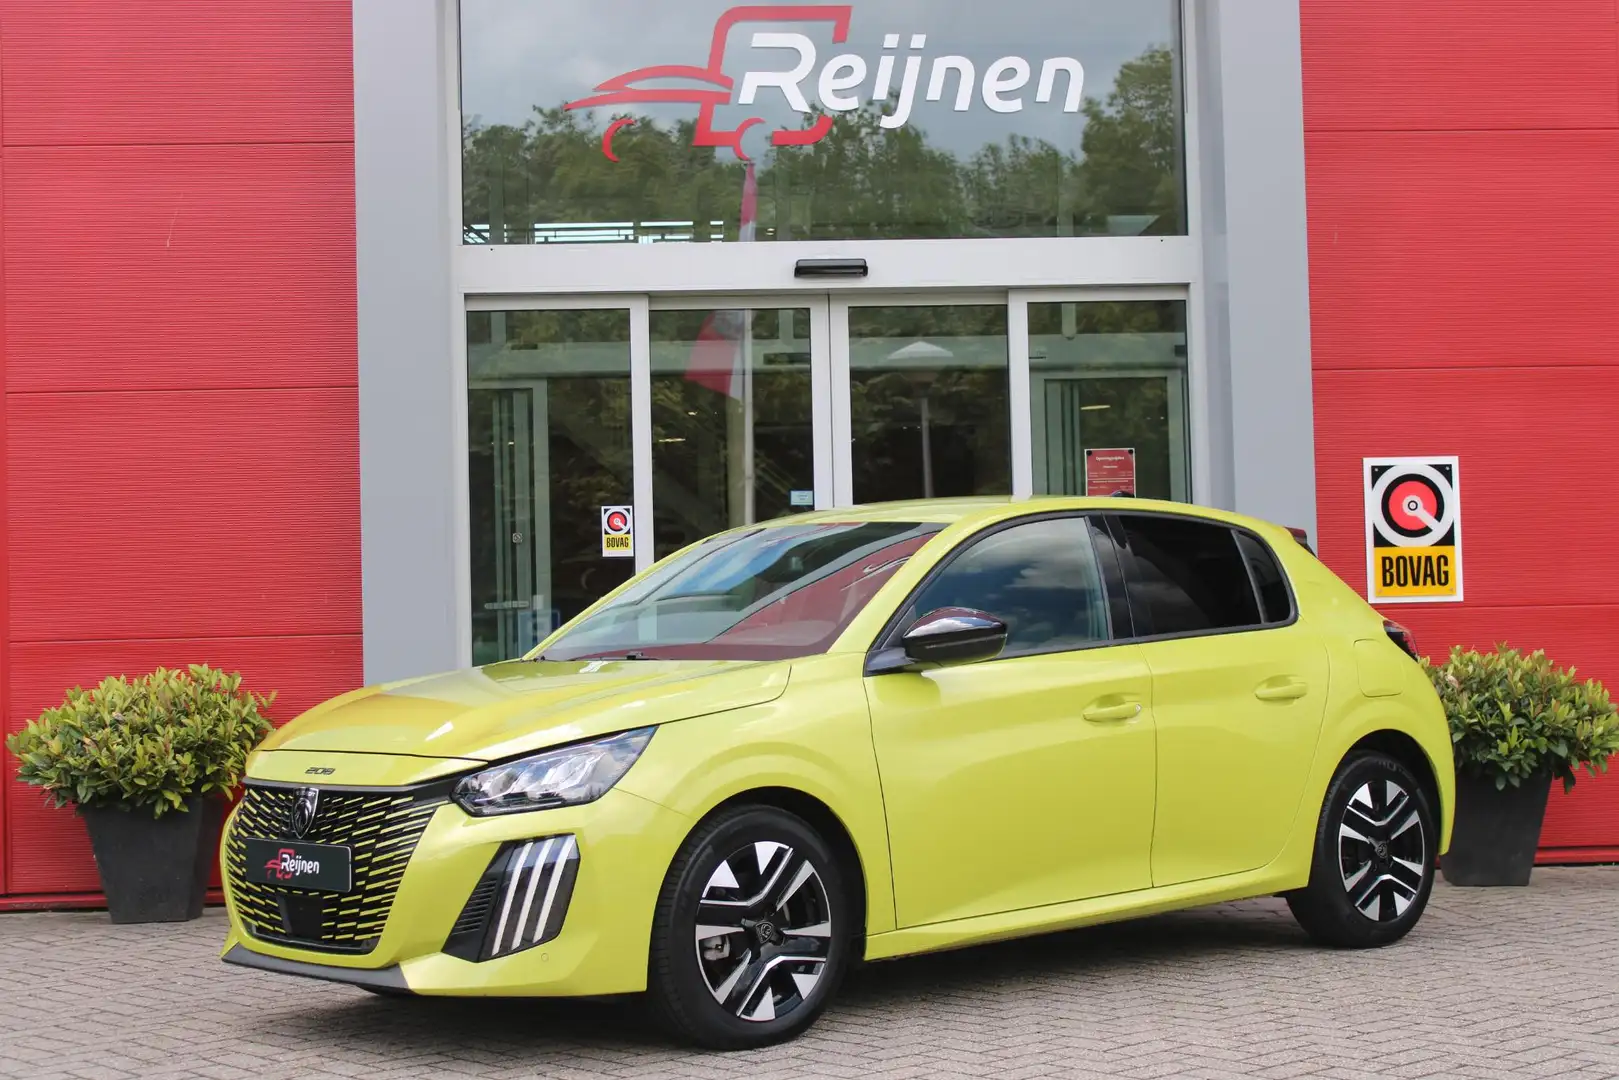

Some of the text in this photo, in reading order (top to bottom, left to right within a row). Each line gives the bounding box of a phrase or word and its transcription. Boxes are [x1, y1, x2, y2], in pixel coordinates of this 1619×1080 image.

[738, 33, 1085, 129] Reijnen
[606, 537, 629, 548] BOVAG
[1381, 555, 1449, 587] BOVAG
[305, 766, 336, 775] 208
[281, 853, 320, 876] Reijnen
